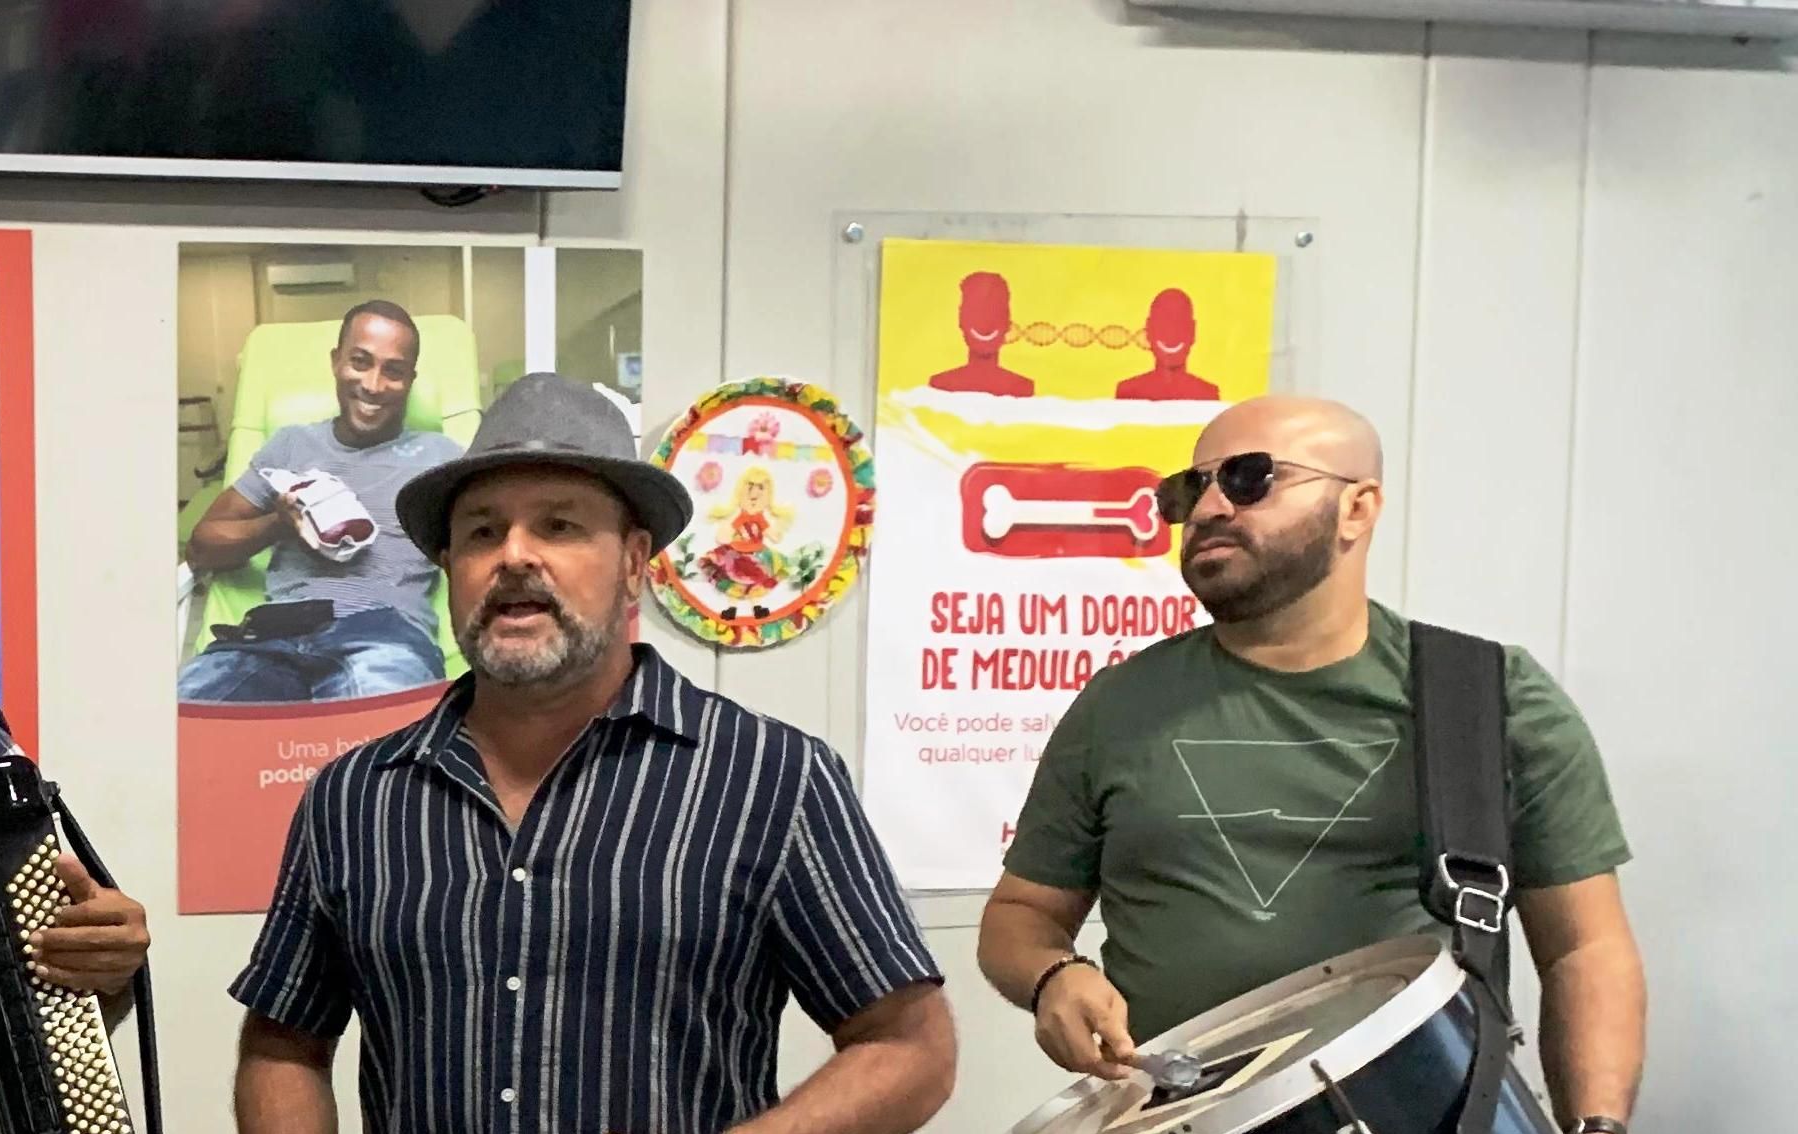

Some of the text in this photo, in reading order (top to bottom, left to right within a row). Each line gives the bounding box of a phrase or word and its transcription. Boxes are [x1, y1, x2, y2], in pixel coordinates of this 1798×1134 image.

[930, 592, 1197, 637] SEJA UM DOADOR
[921, 648, 959, 690] DE
[971, 648, 1093, 691] MEDULA
[894, 712, 949, 732] Você
[956, 713, 1013, 734] pode
[277, 740, 329, 760] Uma
[918, 744, 1016, 764] qualquer
